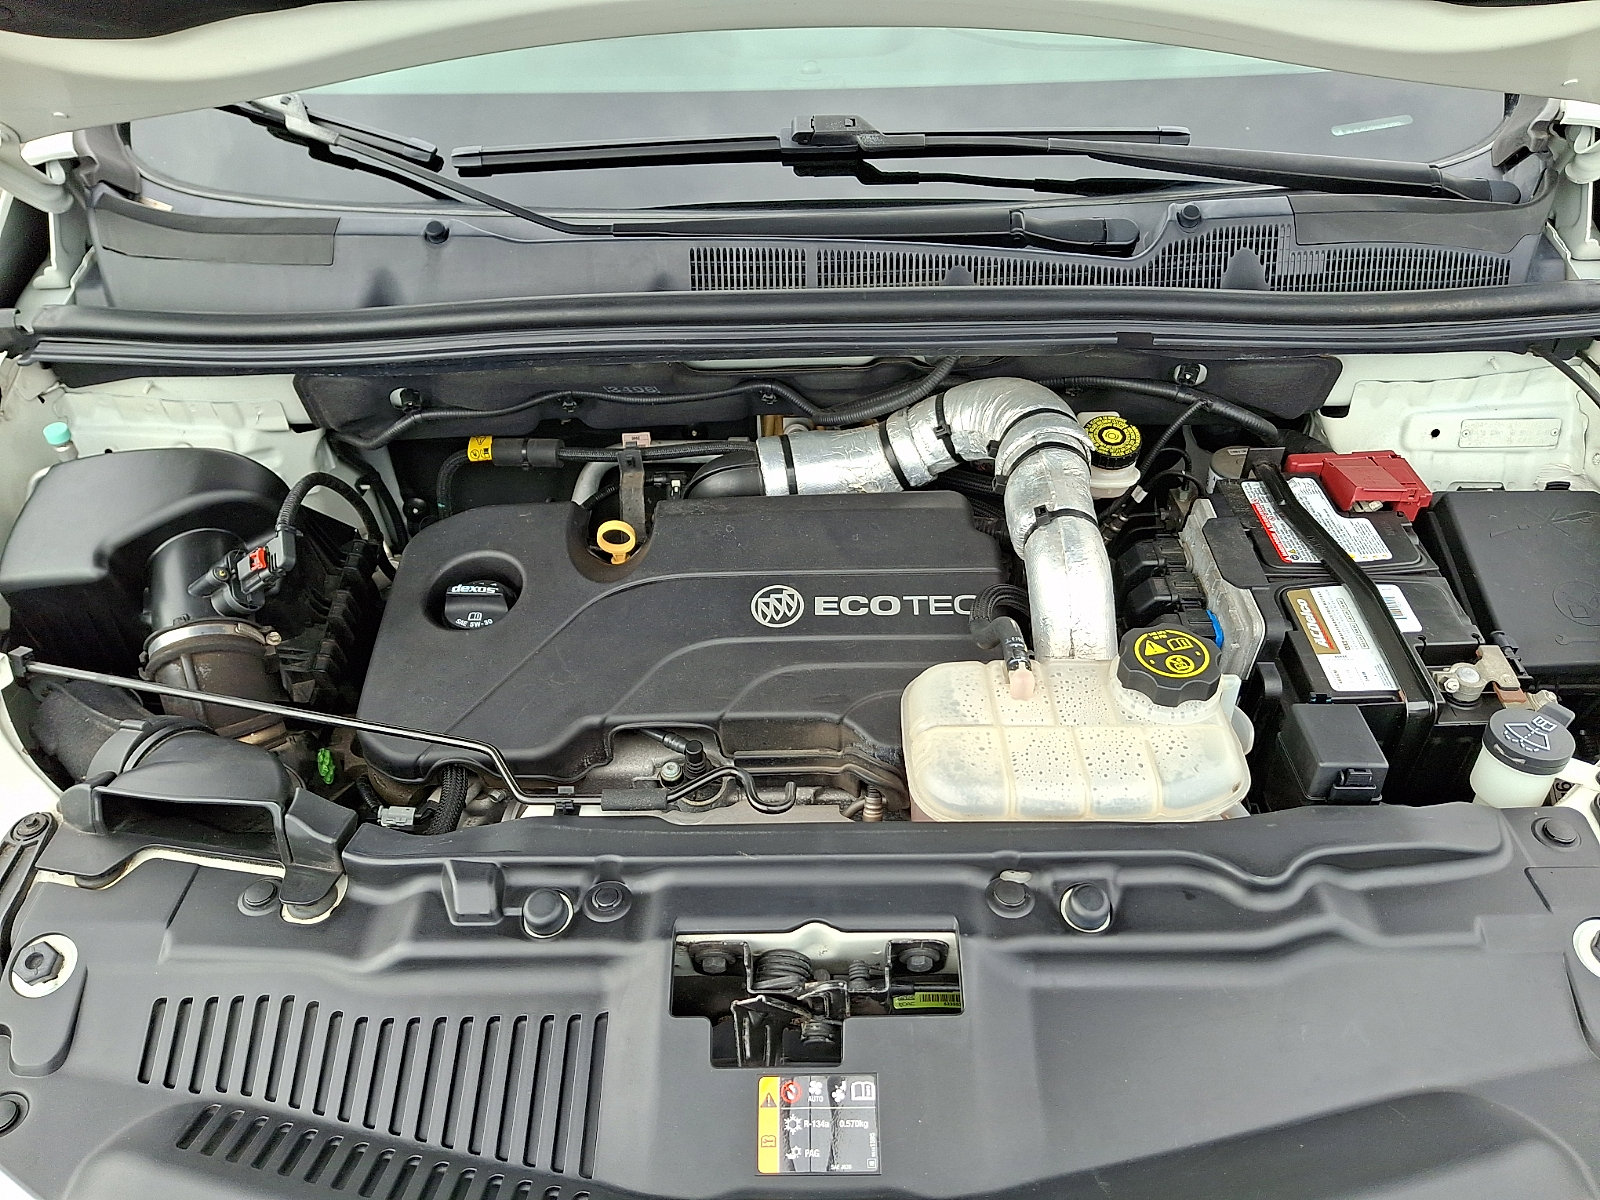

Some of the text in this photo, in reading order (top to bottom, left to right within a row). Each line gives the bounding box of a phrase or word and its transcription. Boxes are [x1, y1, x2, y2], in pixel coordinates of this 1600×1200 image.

[451, 584, 498, 593] dexos
[814, 594, 977, 616] ECOTEC
[455, 618, 493, 627] SAE 5W-30
[803, 1119, 830, 1128] R-134a
[804, 1148, 821, 1158] PAG
